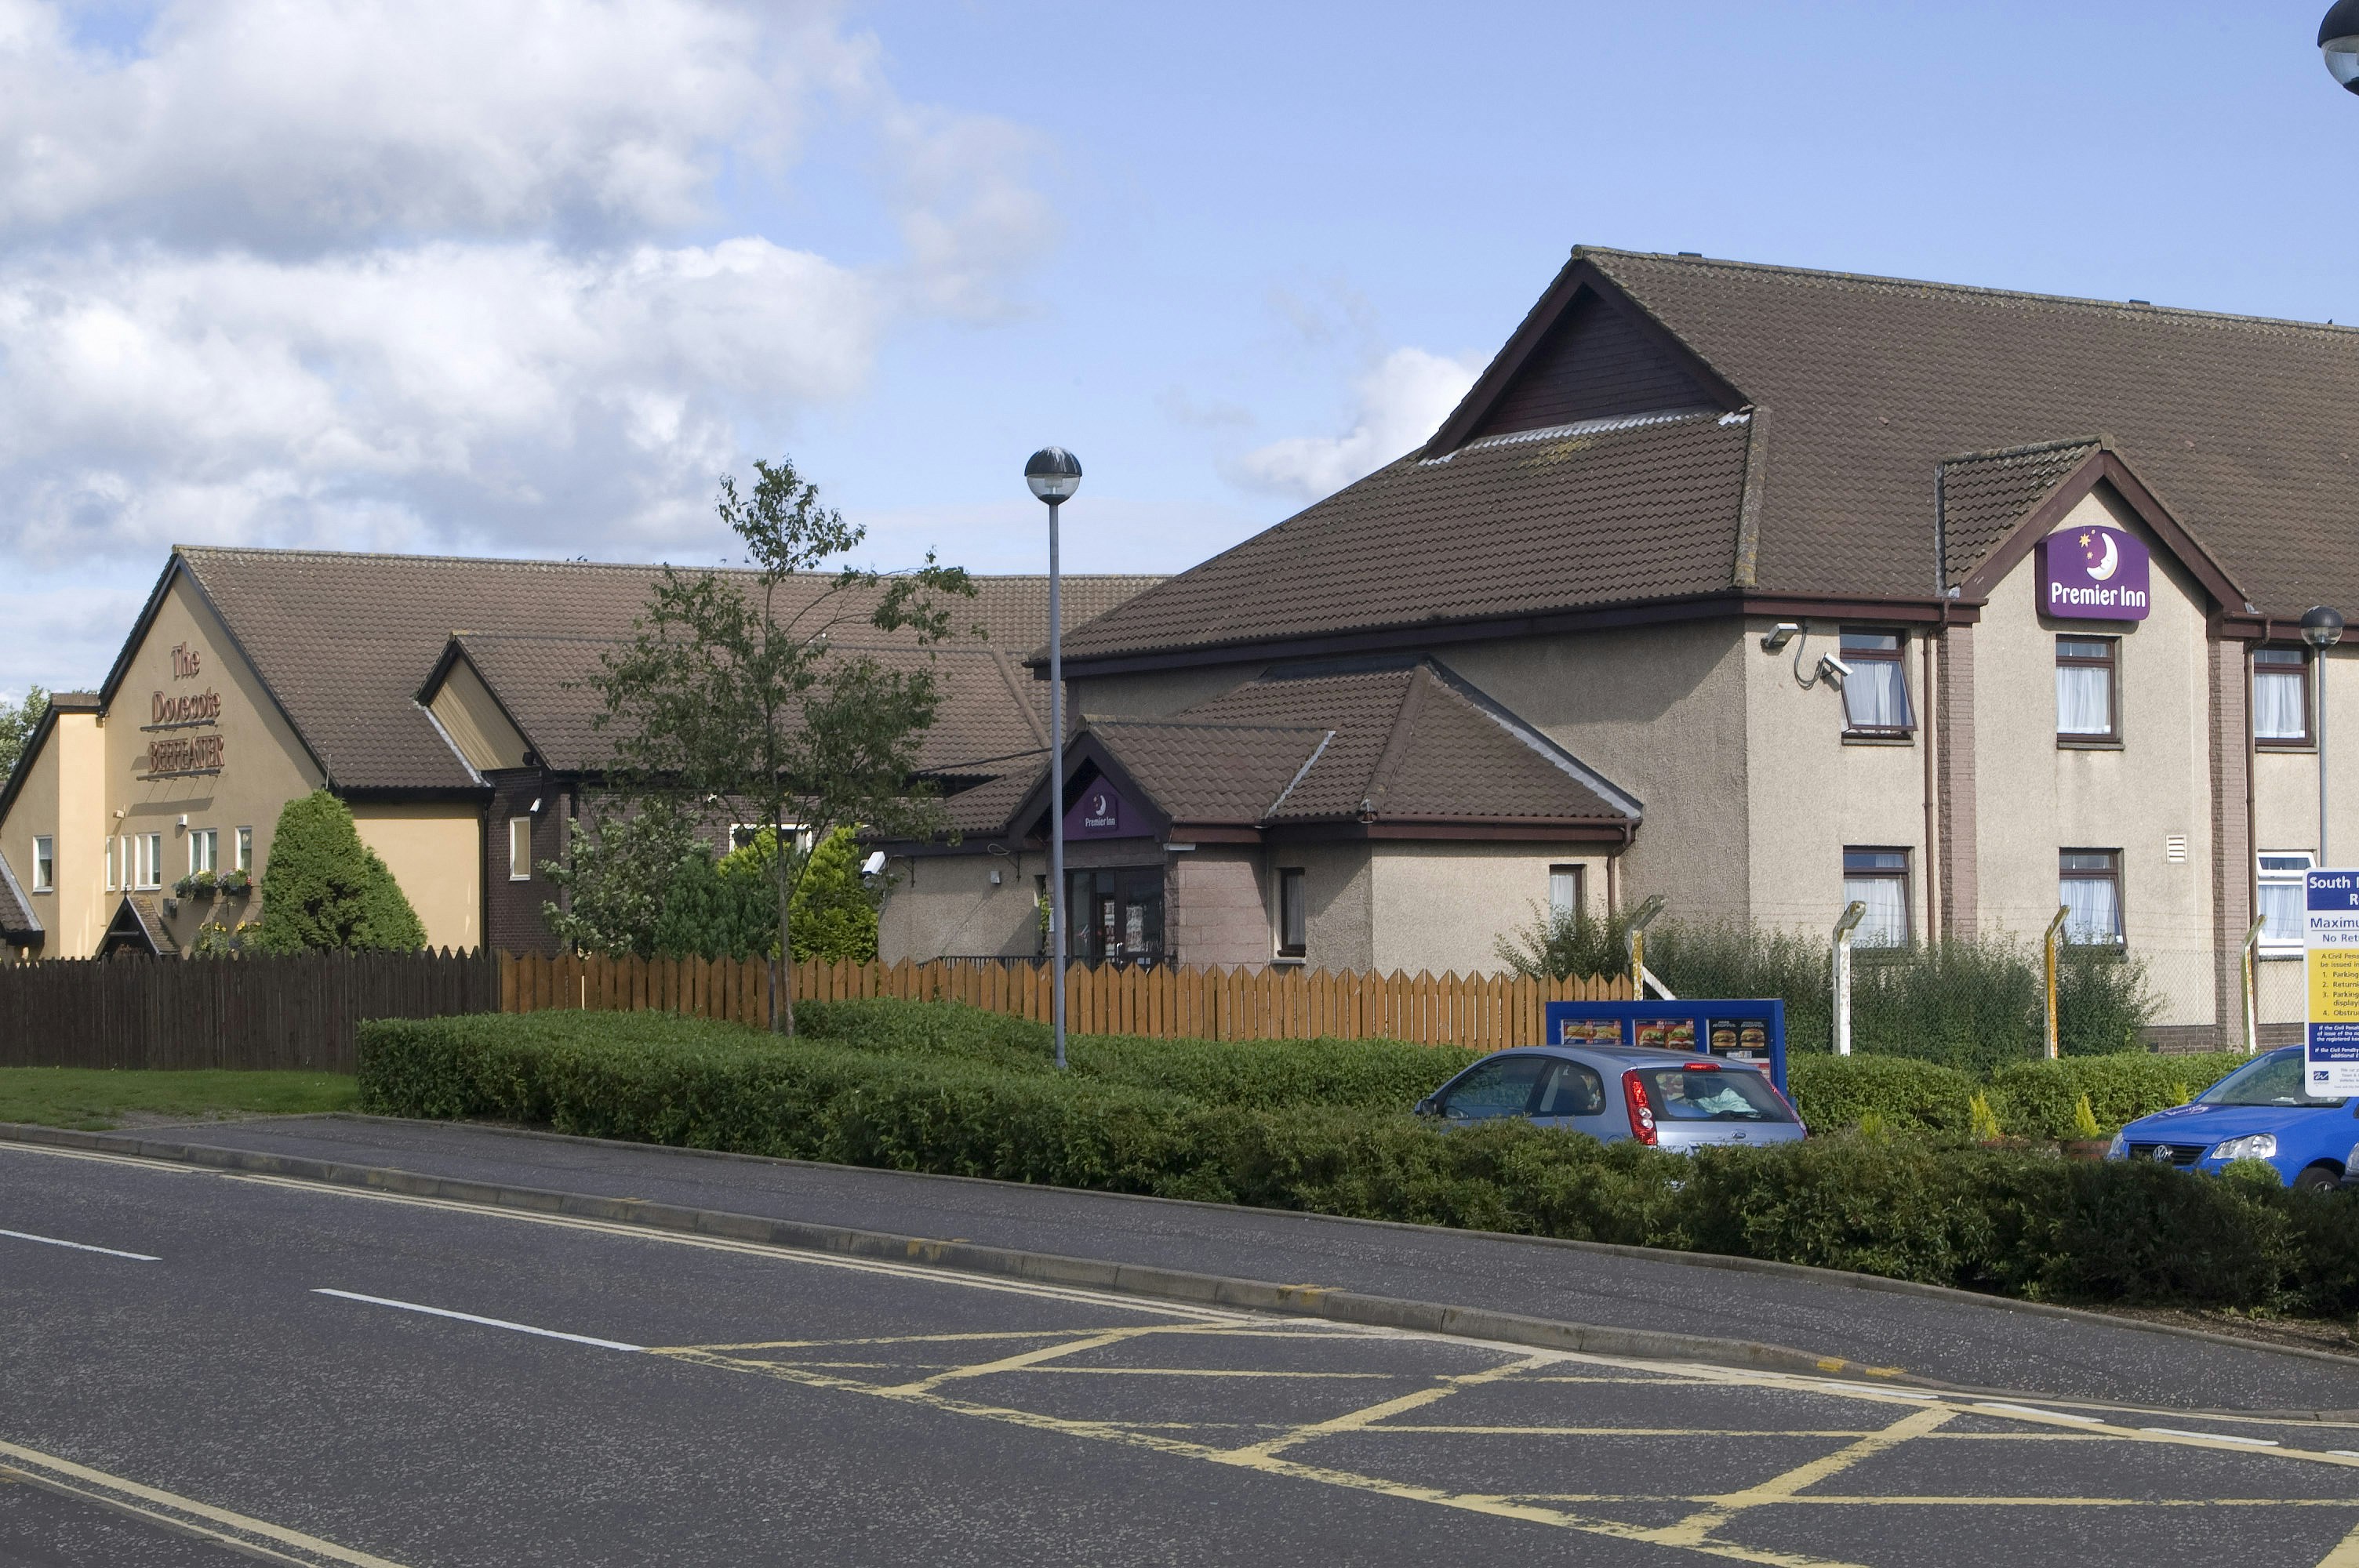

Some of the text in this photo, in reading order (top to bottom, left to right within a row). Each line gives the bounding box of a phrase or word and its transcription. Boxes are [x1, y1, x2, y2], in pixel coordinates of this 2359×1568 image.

[2051, 582, 2146, 608] Premier Inn
[171, 641, 201, 680] The
[152, 687, 221, 723] Dovecote
[149, 734, 225, 773] BEEFEATER
[1085, 816, 1116, 827] Premier Inn
[2309, 875, 2351, 889] South
[2322, 934, 2337, 942] No
